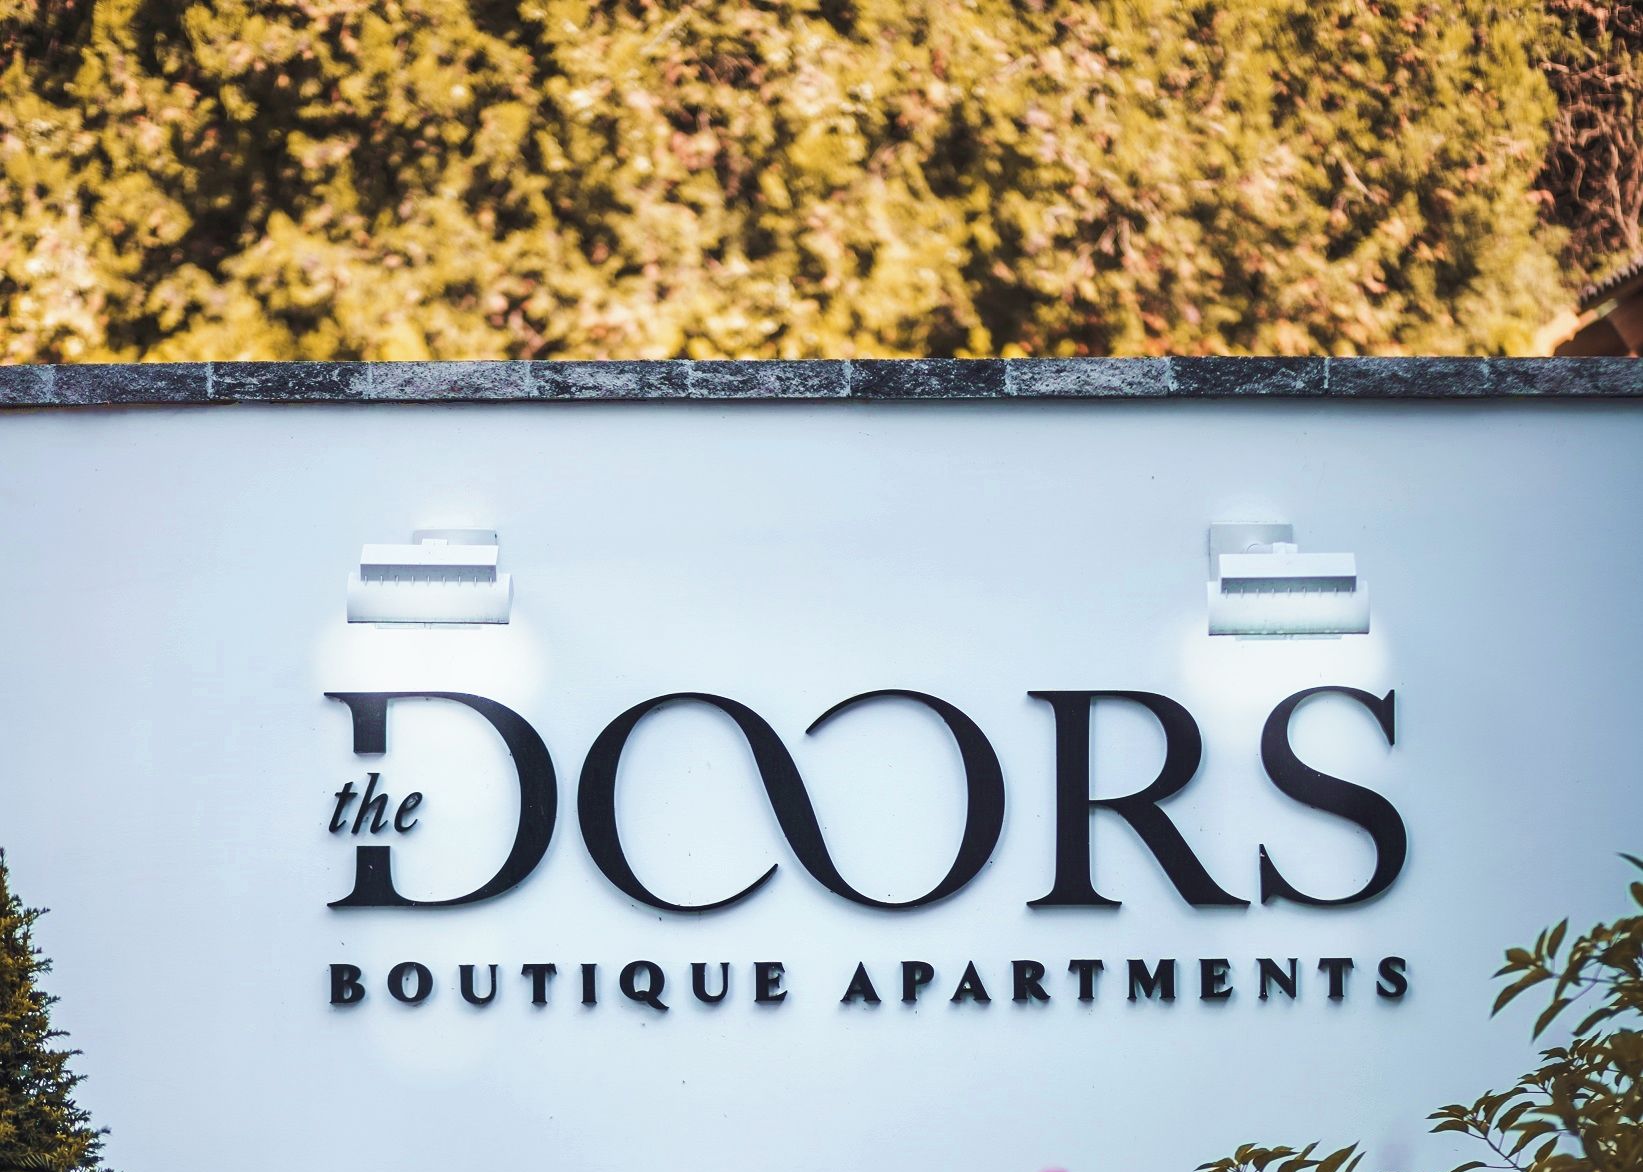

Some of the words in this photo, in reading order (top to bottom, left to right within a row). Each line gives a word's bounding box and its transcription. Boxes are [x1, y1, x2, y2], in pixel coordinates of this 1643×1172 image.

[324, 688, 1408, 911] DOORS
[328, 773, 424, 834] the
[329, 960, 789, 1011] BOUTIQUE
[840, 956, 1409, 1004] APARTMENTS
